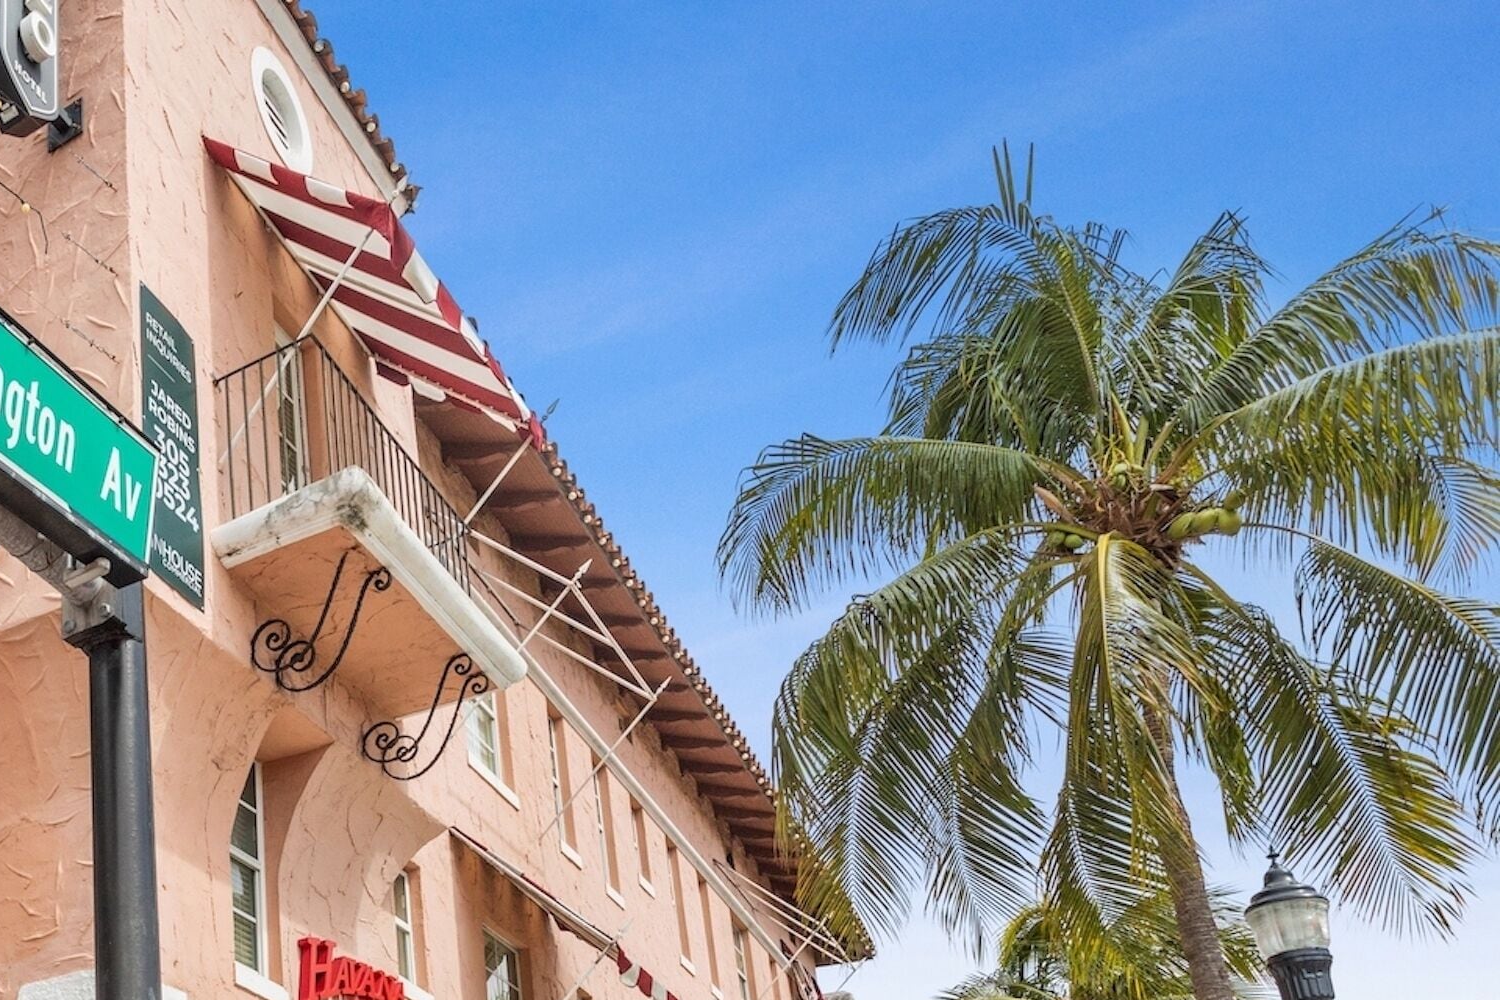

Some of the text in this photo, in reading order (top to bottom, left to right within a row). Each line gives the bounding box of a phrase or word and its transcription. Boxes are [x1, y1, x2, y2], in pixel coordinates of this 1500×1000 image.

[14, 60, 48, 104] HOTEL
[146, 311, 177, 353] RETAIL
[146, 327, 192, 384] INQUIRIES
[147, 396, 196, 454] ROBINS
[150, 379, 192, 430] JARED
[153, 424, 191, 477] 305
[100, 446, 143, 521] Av
[157, 454, 192, 501] 323
